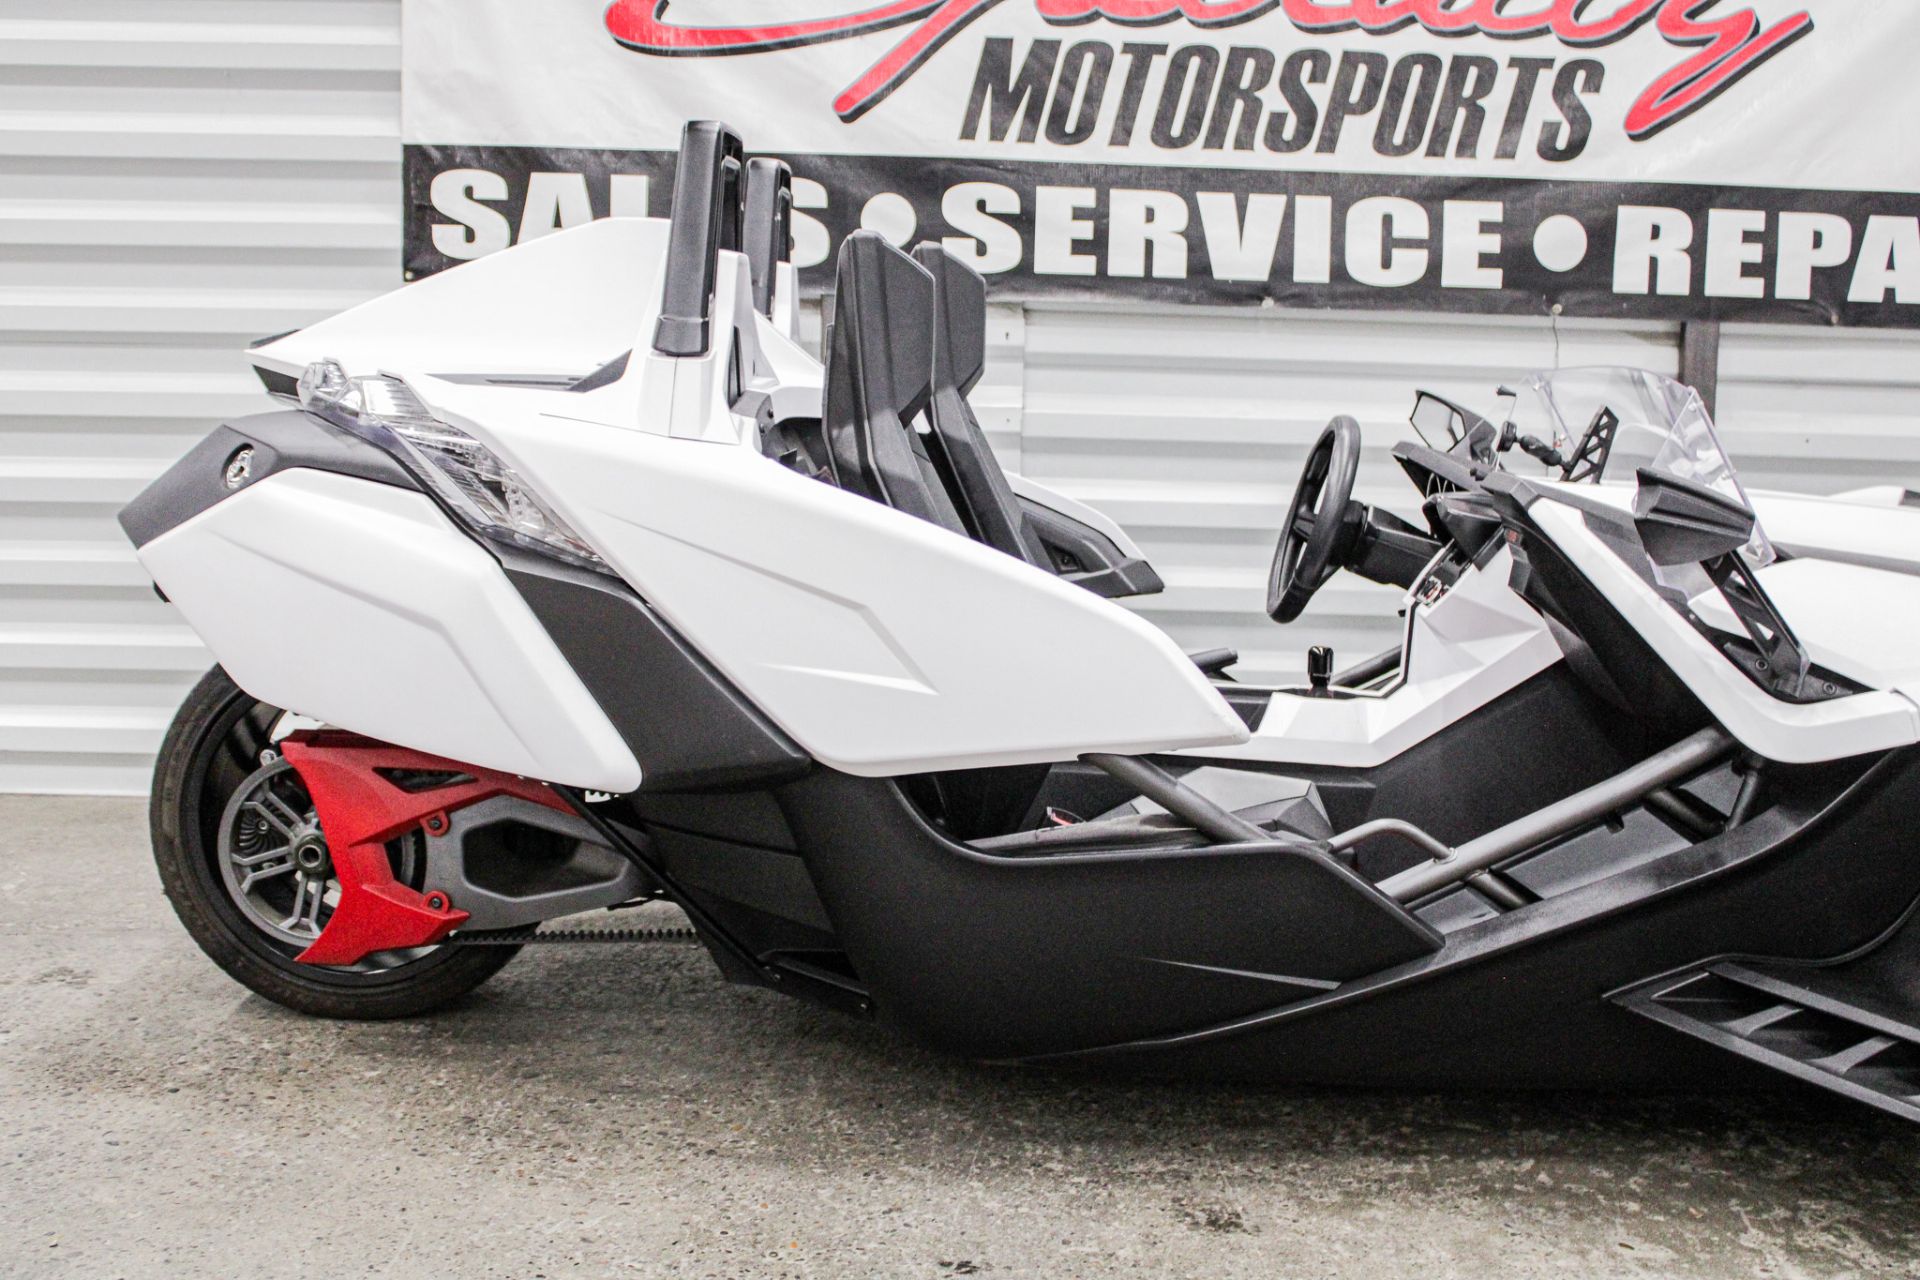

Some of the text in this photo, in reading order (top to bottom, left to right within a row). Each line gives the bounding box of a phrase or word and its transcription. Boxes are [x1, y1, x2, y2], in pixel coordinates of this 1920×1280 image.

[959, 37, 1606, 163] MOTORSPORTS
[429, 168, 1920, 305] SAS SERVICE REPA
